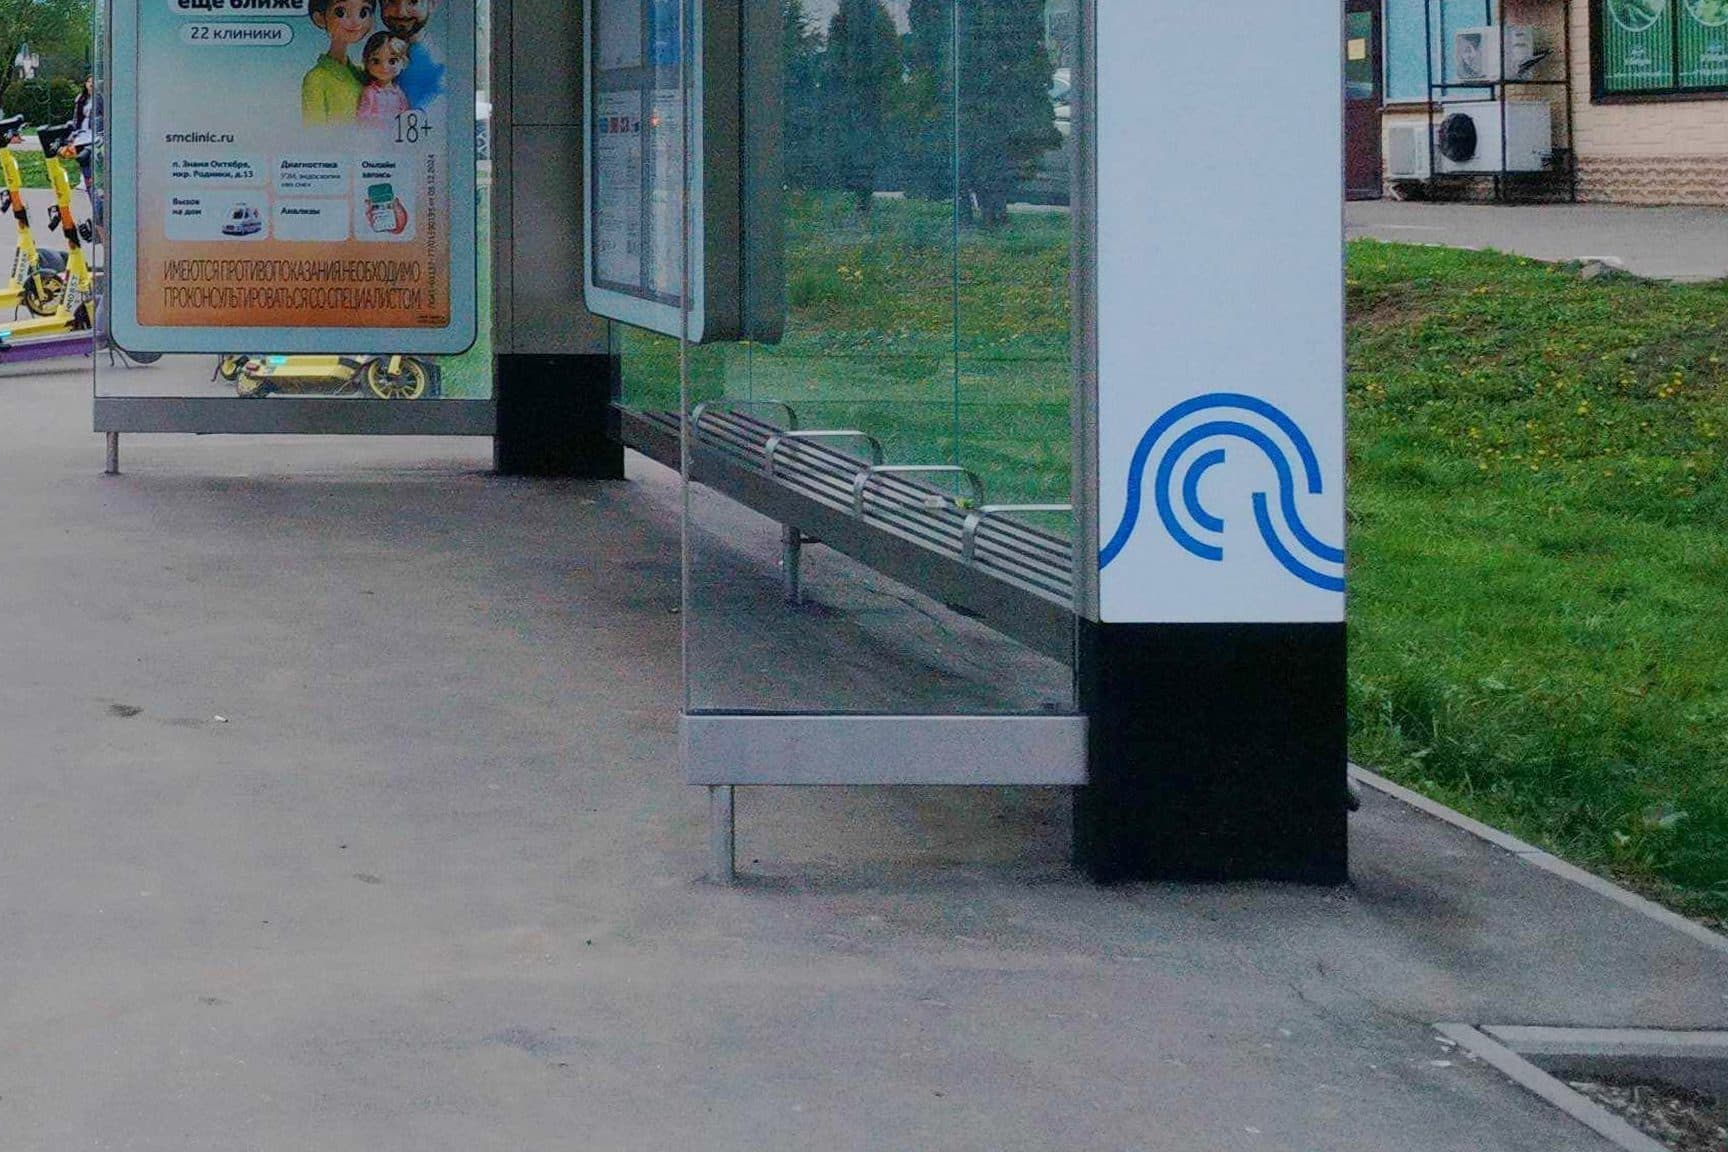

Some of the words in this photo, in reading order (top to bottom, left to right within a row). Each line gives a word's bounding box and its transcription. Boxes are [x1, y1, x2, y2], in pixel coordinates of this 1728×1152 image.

[190, 26, 209, 40] 22
[213, 28, 282, 40] клиники
[394, 113, 433, 143] 18+
[165, 131, 235, 143] smclinic.ru
[280, 160, 339, 169] Диагностика
